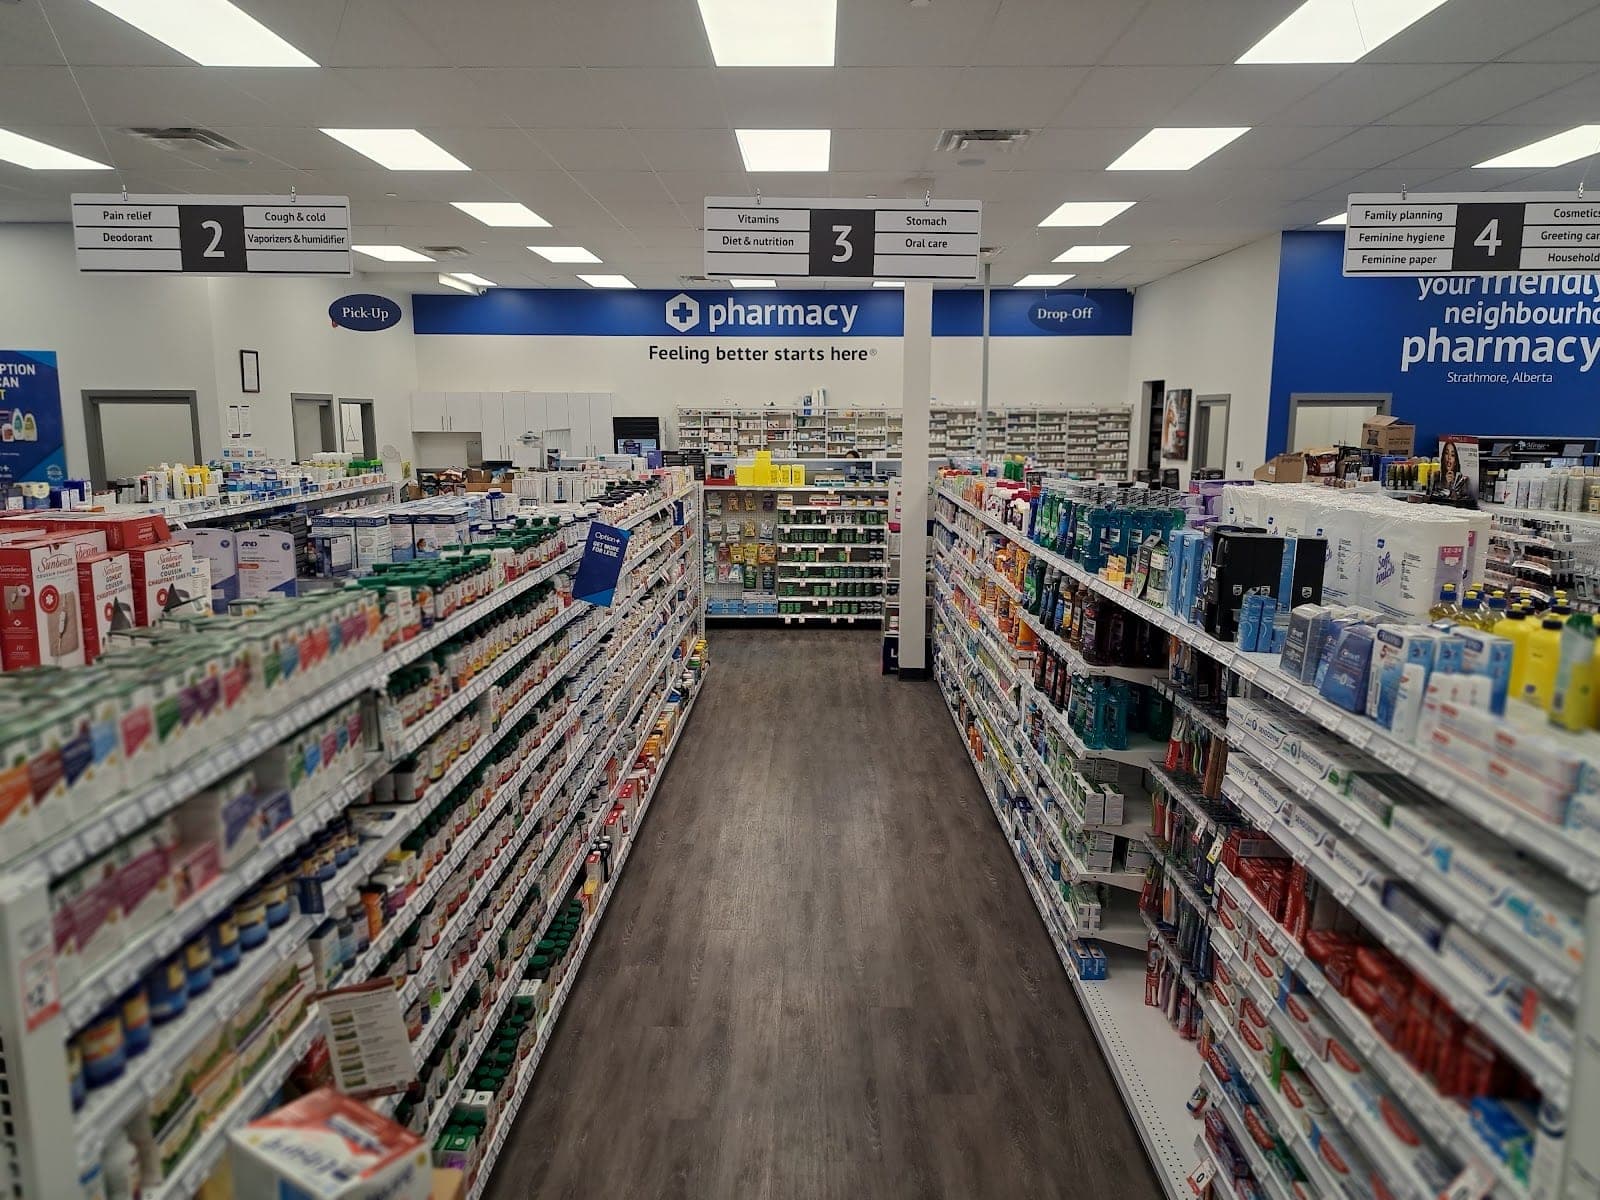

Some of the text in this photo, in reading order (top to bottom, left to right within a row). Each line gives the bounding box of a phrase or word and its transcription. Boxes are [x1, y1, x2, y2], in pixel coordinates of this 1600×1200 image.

[103, 210, 152, 221] Pain relief
[264, 211, 327, 224] Cough & cold
[738, 214, 780, 225] Vitamins
[1364, 210, 1443, 223] Family planning
[1553, 208, 1600, 218] Cosmetics
[906, 215, 947, 228] Stomach
[103, 232, 153, 243] Deodorant
[200, 220, 225, 258] 2
[248, 234, 345, 246] Vaporizers & humidifier
[722, 235, 794, 247] Diet & nutrition
[1359, 232, 1446, 244] Feminine hygiene
[1473, 219, 1502, 257] 4
[1540, 231, 1584, 242] Greeting
[831, 225, 854, 263] 3
[905, 238, 948, 249] Oral care
[1361, 254, 1437, 266] Feminine paper
[1547, 253, 1600, 262] Household
[1418, 277, 1476, 301] your
[342, 306, 389, 322] Pick-Up
[708, 297, 858, 333] pharmacy
[1037, 307, 1094, 323] Drop-Off
[649, 346, 710, 364] Feeling
[716, 346, 769, 361] better
[774, 347, 825, 361] starts
[1400, 327, 1600, 373] pharmacy
[1446, 371, 1553, 384] Strathmore, Alberta
[37, 554, 74, 573] Sunbeam
